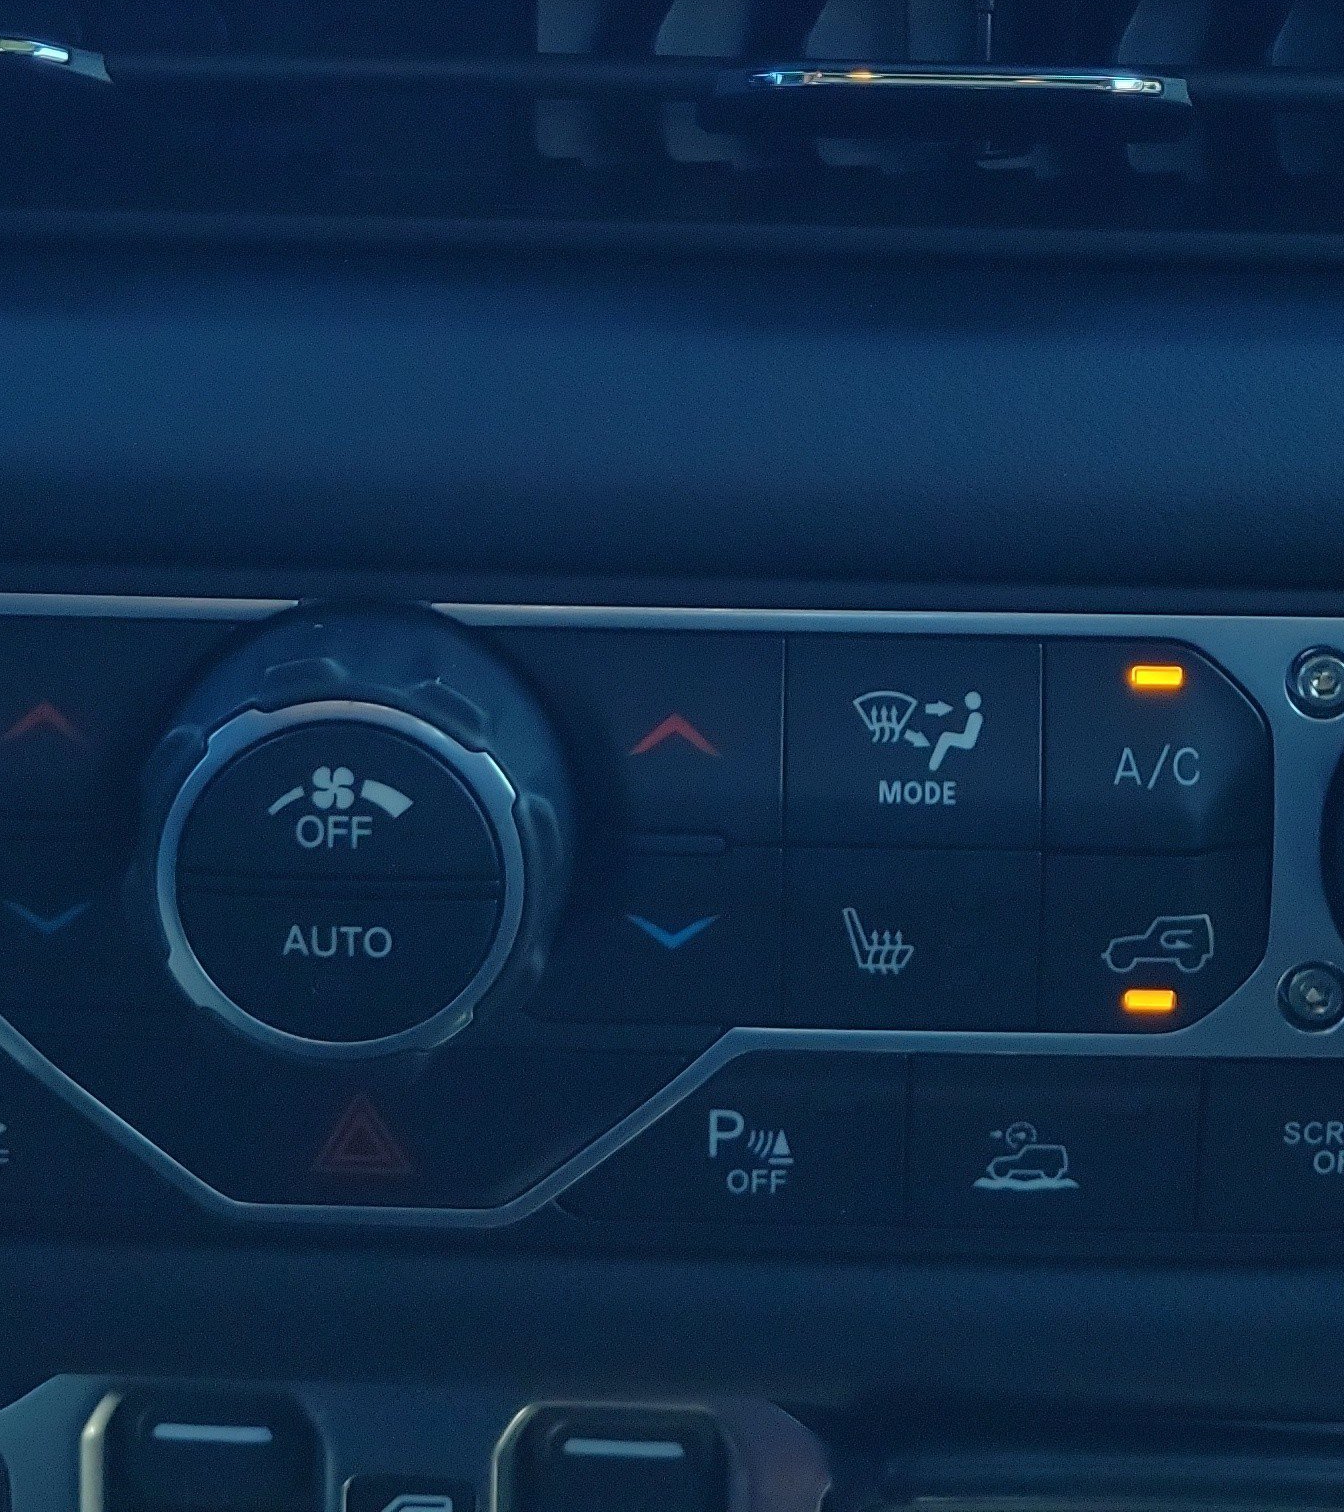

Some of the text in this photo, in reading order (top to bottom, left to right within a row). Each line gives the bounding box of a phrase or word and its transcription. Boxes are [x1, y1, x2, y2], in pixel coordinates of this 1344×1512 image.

[1113, 743, 1202, 791] A/C
[877, 779, 957, 806] MODE
[294, 813, 374, 850] OFF
[281, 923, 394, 959] AUTO
[708, 1108, 744, 1159] P
[725, 1167, 788, 1195] OFF
